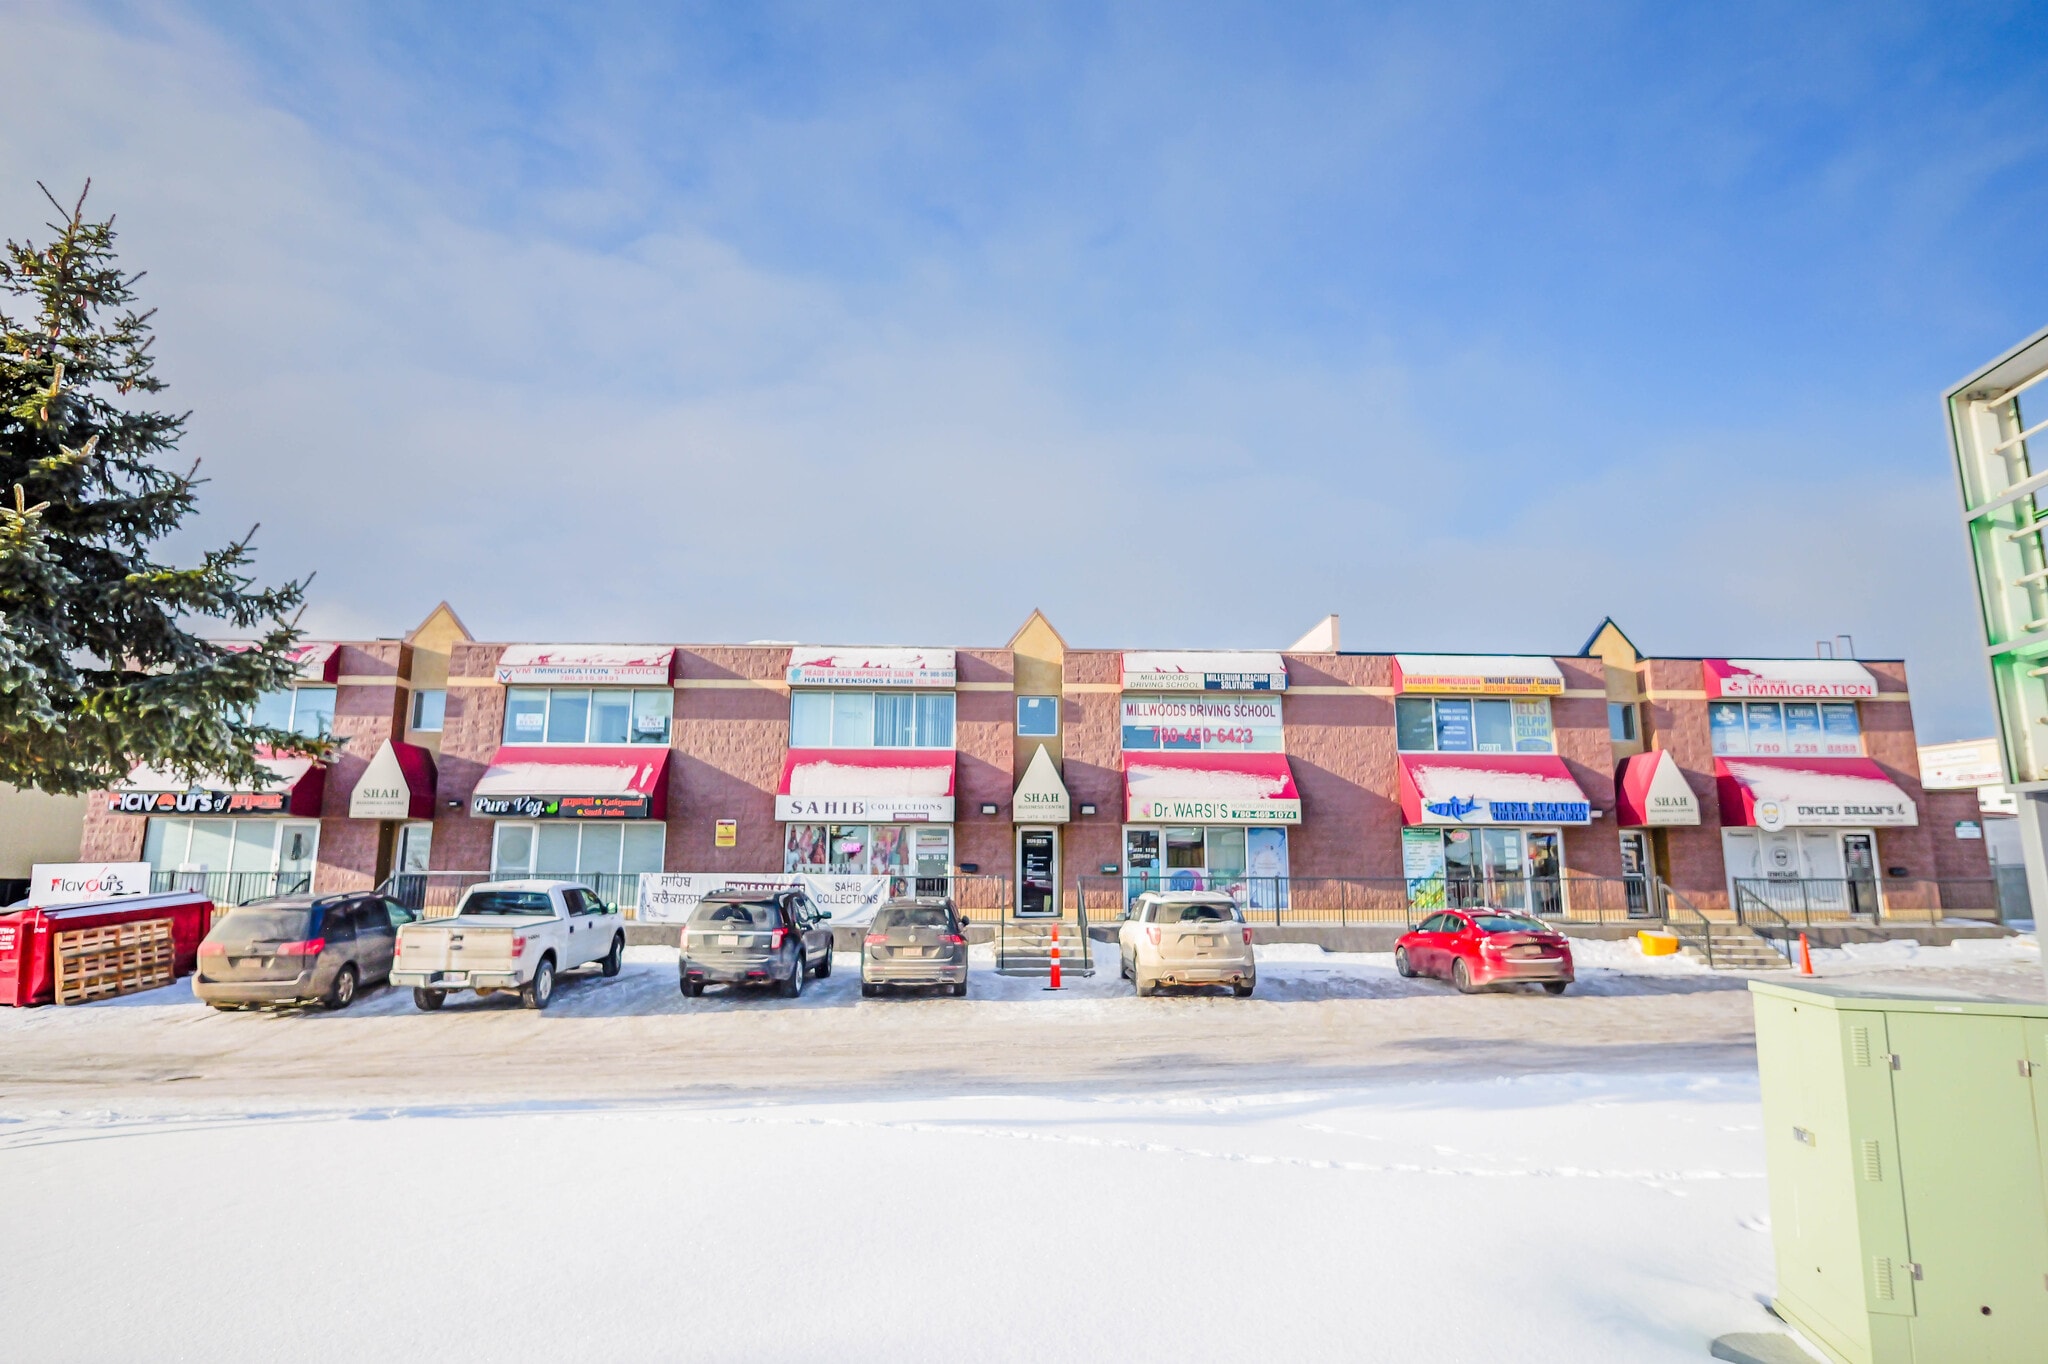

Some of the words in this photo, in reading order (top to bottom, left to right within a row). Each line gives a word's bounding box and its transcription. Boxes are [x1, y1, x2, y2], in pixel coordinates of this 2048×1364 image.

[515, 666, 532, 674] VM
[534, 667, 609, 675] IMMIGRATION
[614, 668, 666, 676] SERVICES
[1206, 673, 1240, 681] MILLENIUM
[1242, 673, 1268, 682] BRACING
[1507, 677, 1535, 685] ACADEMY
[1220, 681, 1255, 690] SOLUTIONS
[1747, 683, 1872, 696] IMMIGRATION
[1126, 704, 1187, 717] MILLWOODS
[1190, 704, 1231, 717] DRIVING
[1234, 704, 1276, 717] SCHOOL
[1515, 701, 1546, 715] IELTS
[1516, 716, 1547, 727] CELPIP
[1151, 727, 1254, 744] 780-450-6423
[1755, 743, 1780, 753] 780
[363, 788, 399, 798] SHAH
[1024, 793, 1059, 802] SHAH
[474, 797, 511, 813] Pure
[514, 796, 546, 817] Veg.
[1655, 797, 1688, 806] SHAH
[790, 801, 864, 814] SAHIB
[870, 803, 943, 811] COLLECTIONS
[1154, 803, 1172, 817] Dr.
[1174, 803, 1228, 818] WARSI'S
[1489, 802, 1529, 812] FRESH
[1533, 802, 1588, 812] SEAFOOD
[1798, 806, 1839, 815] UNCLE
[1844, 806, 1895, 815] BRIAN'S
[835, 881, 862, 892] SAHIB
[816, 893, 879, 905] COLLECTIONS
